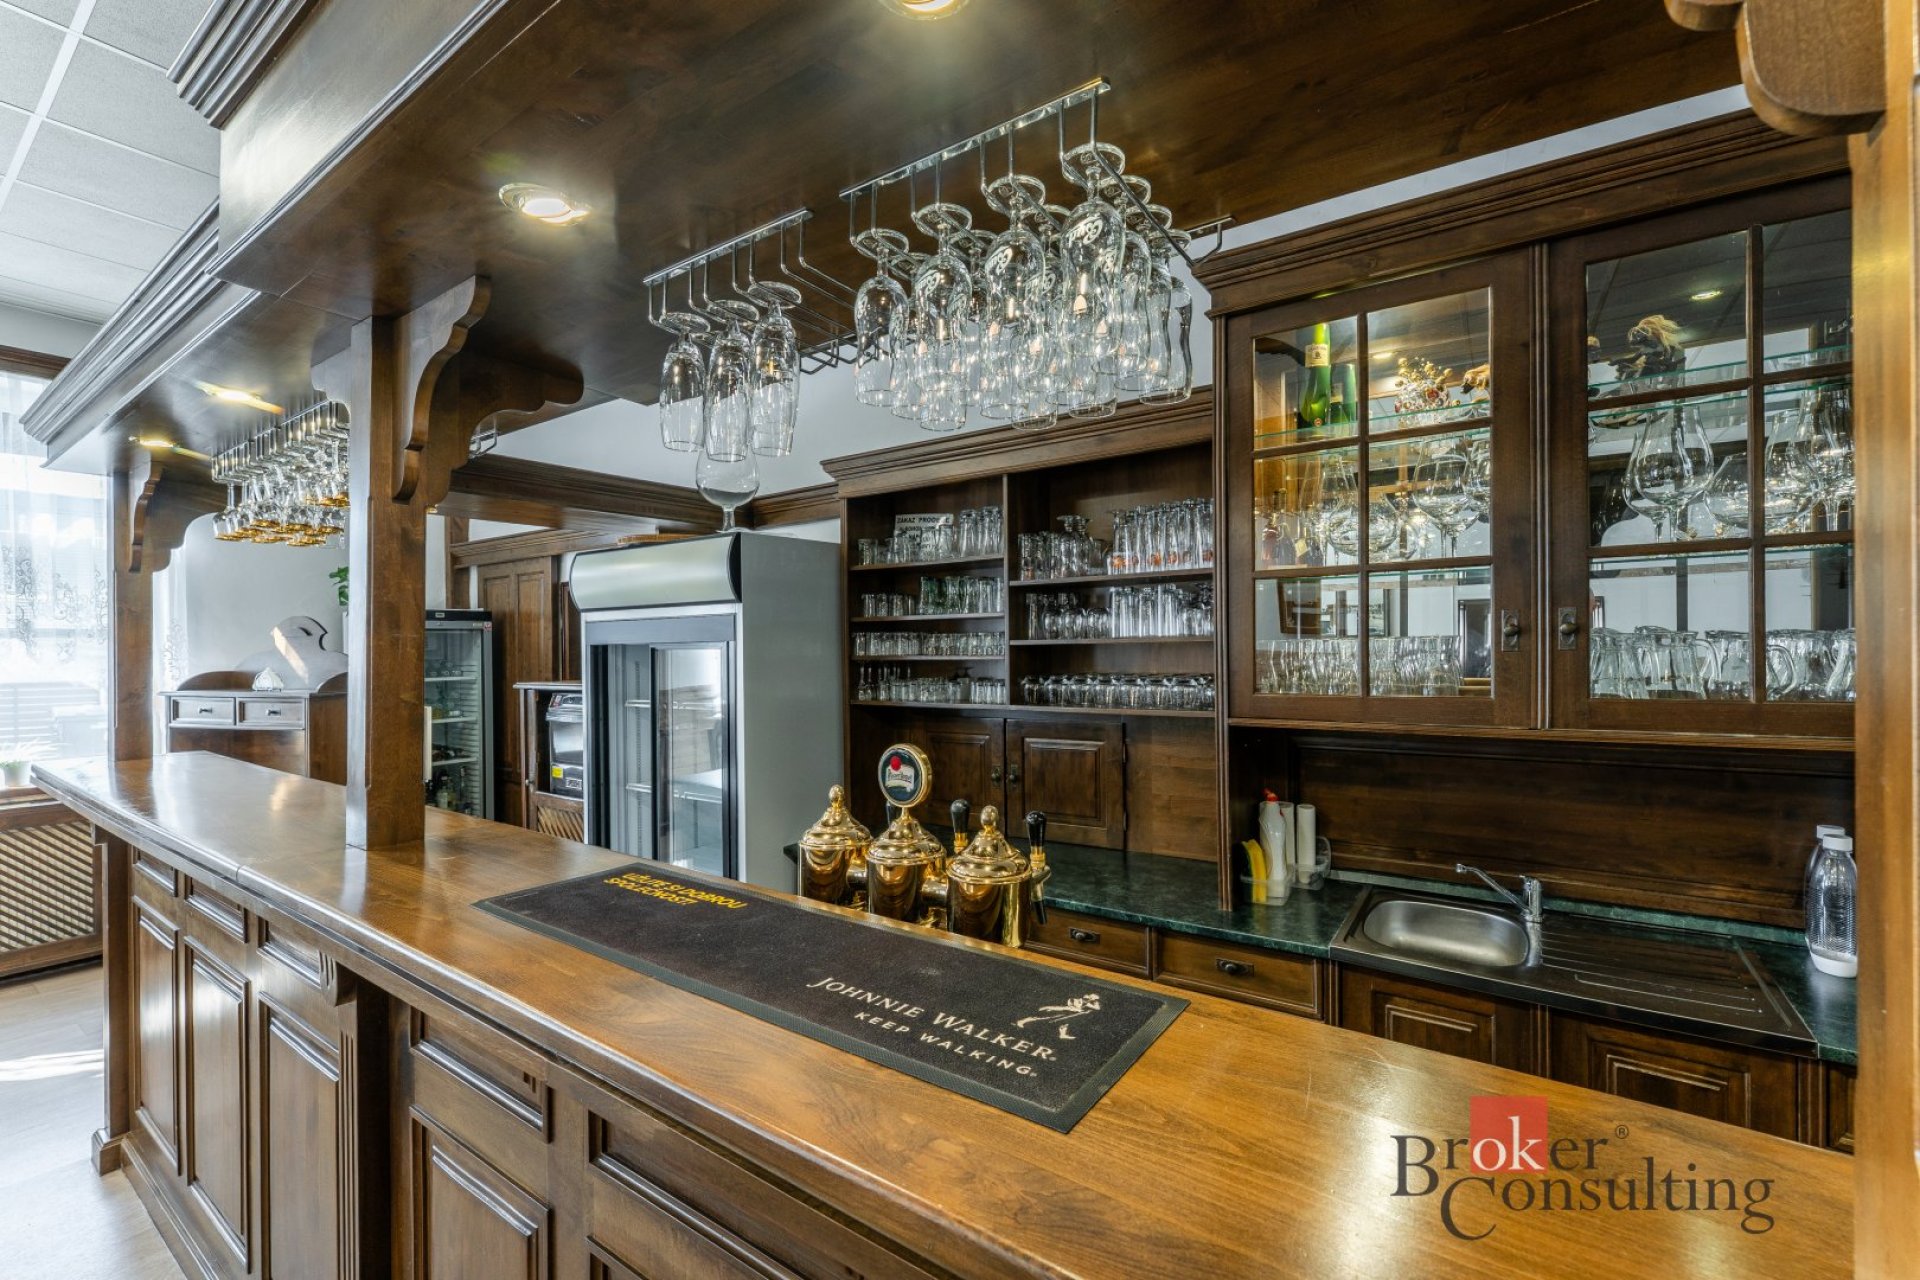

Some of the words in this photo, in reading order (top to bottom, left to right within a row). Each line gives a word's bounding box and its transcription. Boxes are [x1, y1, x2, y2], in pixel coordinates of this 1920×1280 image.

[1066, 213, 1103, 248] Bud
[678, 886, 748, 909] DOBROU
[806, 977, 924, 1018] JOHNNIE
[854, 1011, 910, 1033] KEEP
